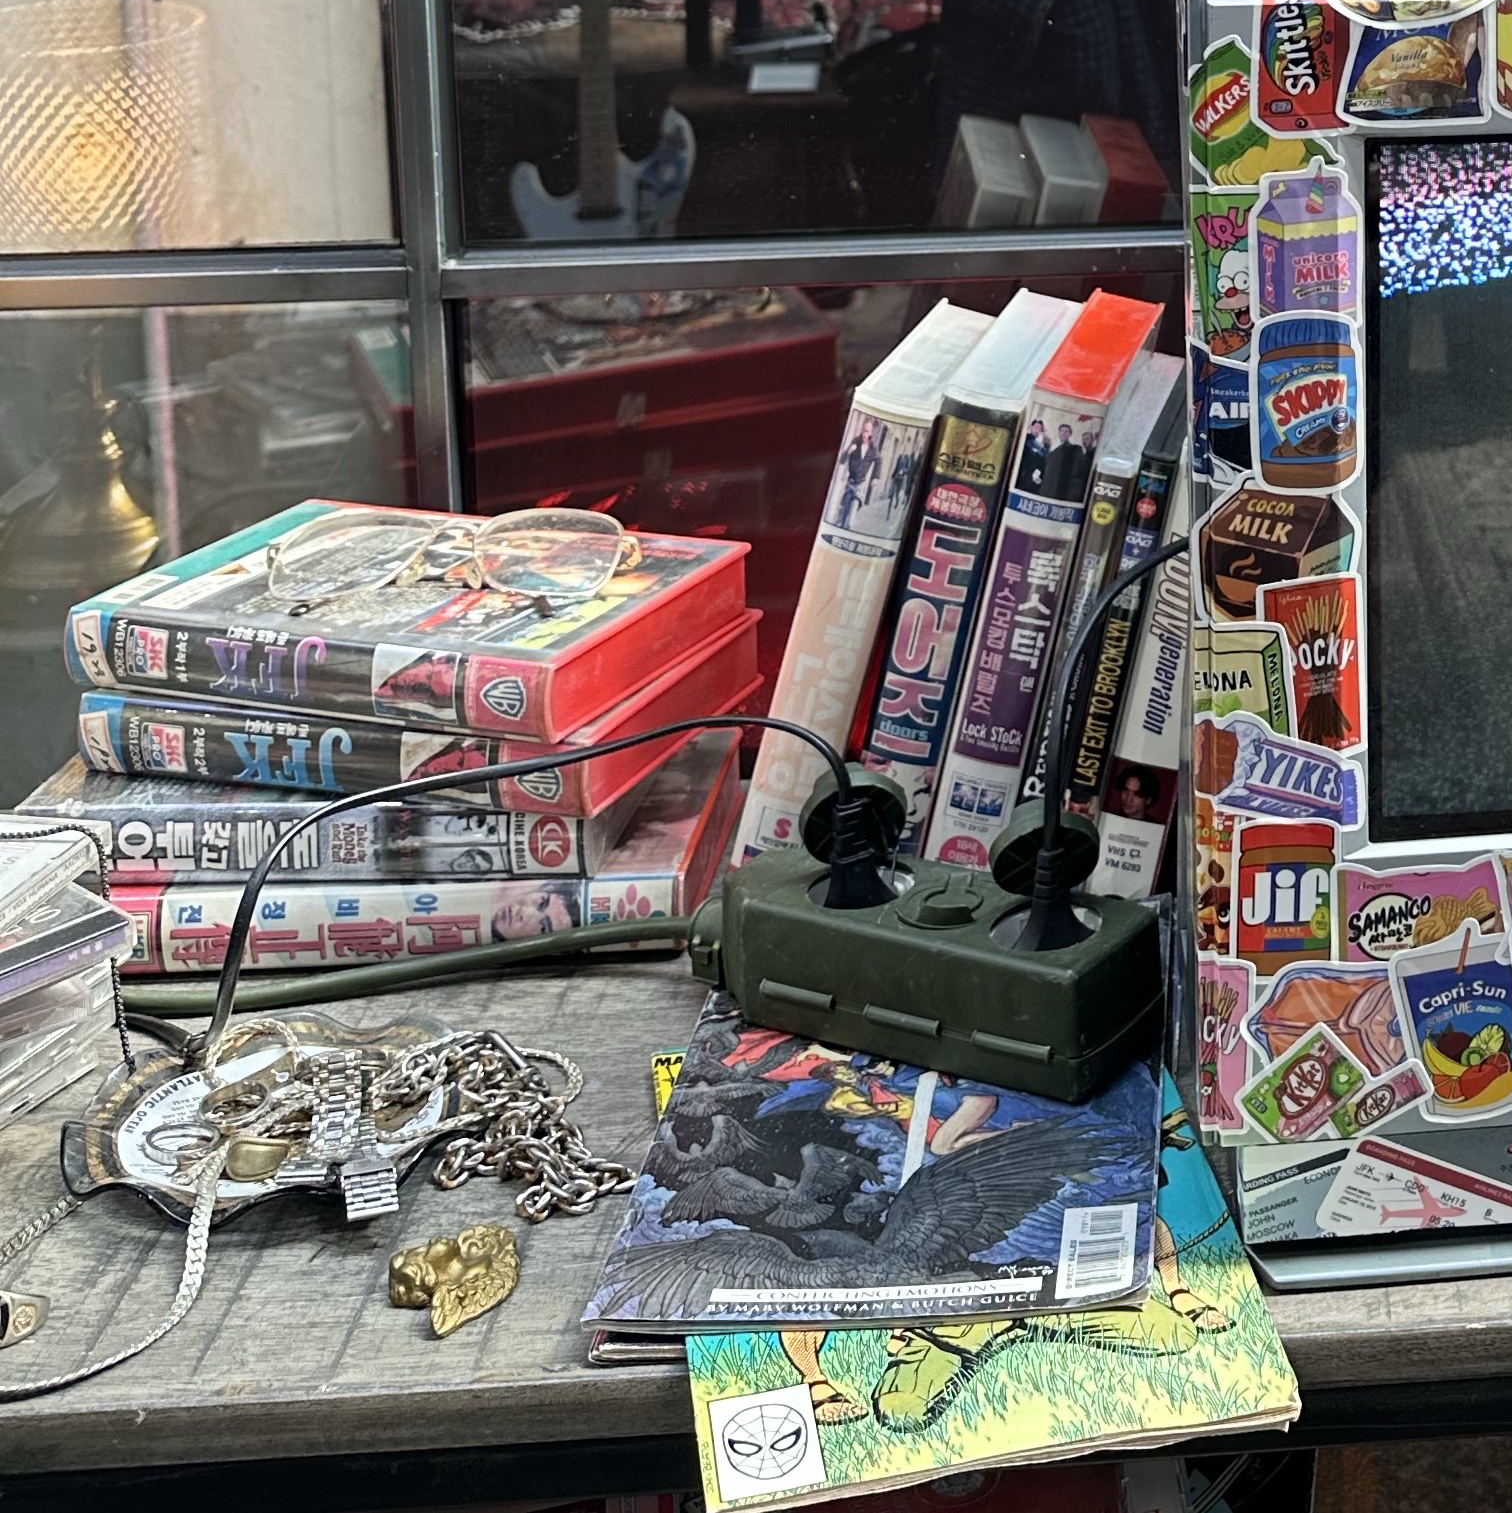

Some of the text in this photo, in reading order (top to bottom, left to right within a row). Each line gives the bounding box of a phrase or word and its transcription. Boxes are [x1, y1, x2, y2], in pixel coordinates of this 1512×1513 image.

[1196, 75, 1250, 132] WALKERS
[1262, 245, 1276, 304] MILK
[1292, 250, 1349, 268] unicorn
[1294, 262, 1350, 285] MILK
[1272, 379, 1346, 427] SKIPPY
[1246, 498, 1295, 516] COCOA
[1228, 513, 1293, 544] MILK
[113, 618, 129, 678] WB12306
[135, 639, 146, 667] PRO
[149, 637, 164, 674] SKC
[206, 635, 327, 701] JFK
[1142, 631, 1185, 735] generation
[1268, 652, 1285, 722] MELONA
[1073, 618, 1132, 787] LAST EXIT TO BROOKLYN
[150, 735, 160, 763] PRO
[879, 718, 930, 742] doors
[165, 732, 183, 768] SKC
[224, 726, 352, 792] JFK
[1260, 748, 1343, 803] YIKES
[100, 820, 196, 872] 튀어
[201, 821, 231, 871] 갖고
[331, 823, 342, 863] and Run
[340, 822, 357, 866] Money
[355, 823, 369, 845] Take
[514, 811, 527, 871] CINE KOREA
[1241, 868, 1330, 925] Jif
[1348, 894, 1432, 943] SAMANCO
[1418, 980, 1508, 1014] Capri-Sun
[147, 1071, 204, 1109] ATLANTIC
[1277, 1166, 1300, 1181] PASS
[1355, 1163, 1376, 1176] JFK
[1246, 1219, 1296, 1242] MOSCOW
[1247, 1212, 1276, 1230] JOHN
[707, 1304, 735, 1313] BY
[737, 1303, 791, 1312] MARV
[792, 1302, 884, 1313] WOLFMAN
[892, 1301, 904, 1310] &
[911, 1298, 973, 1309] BUTCH
[756, 1288, 888, 1301] CONFLICTING
